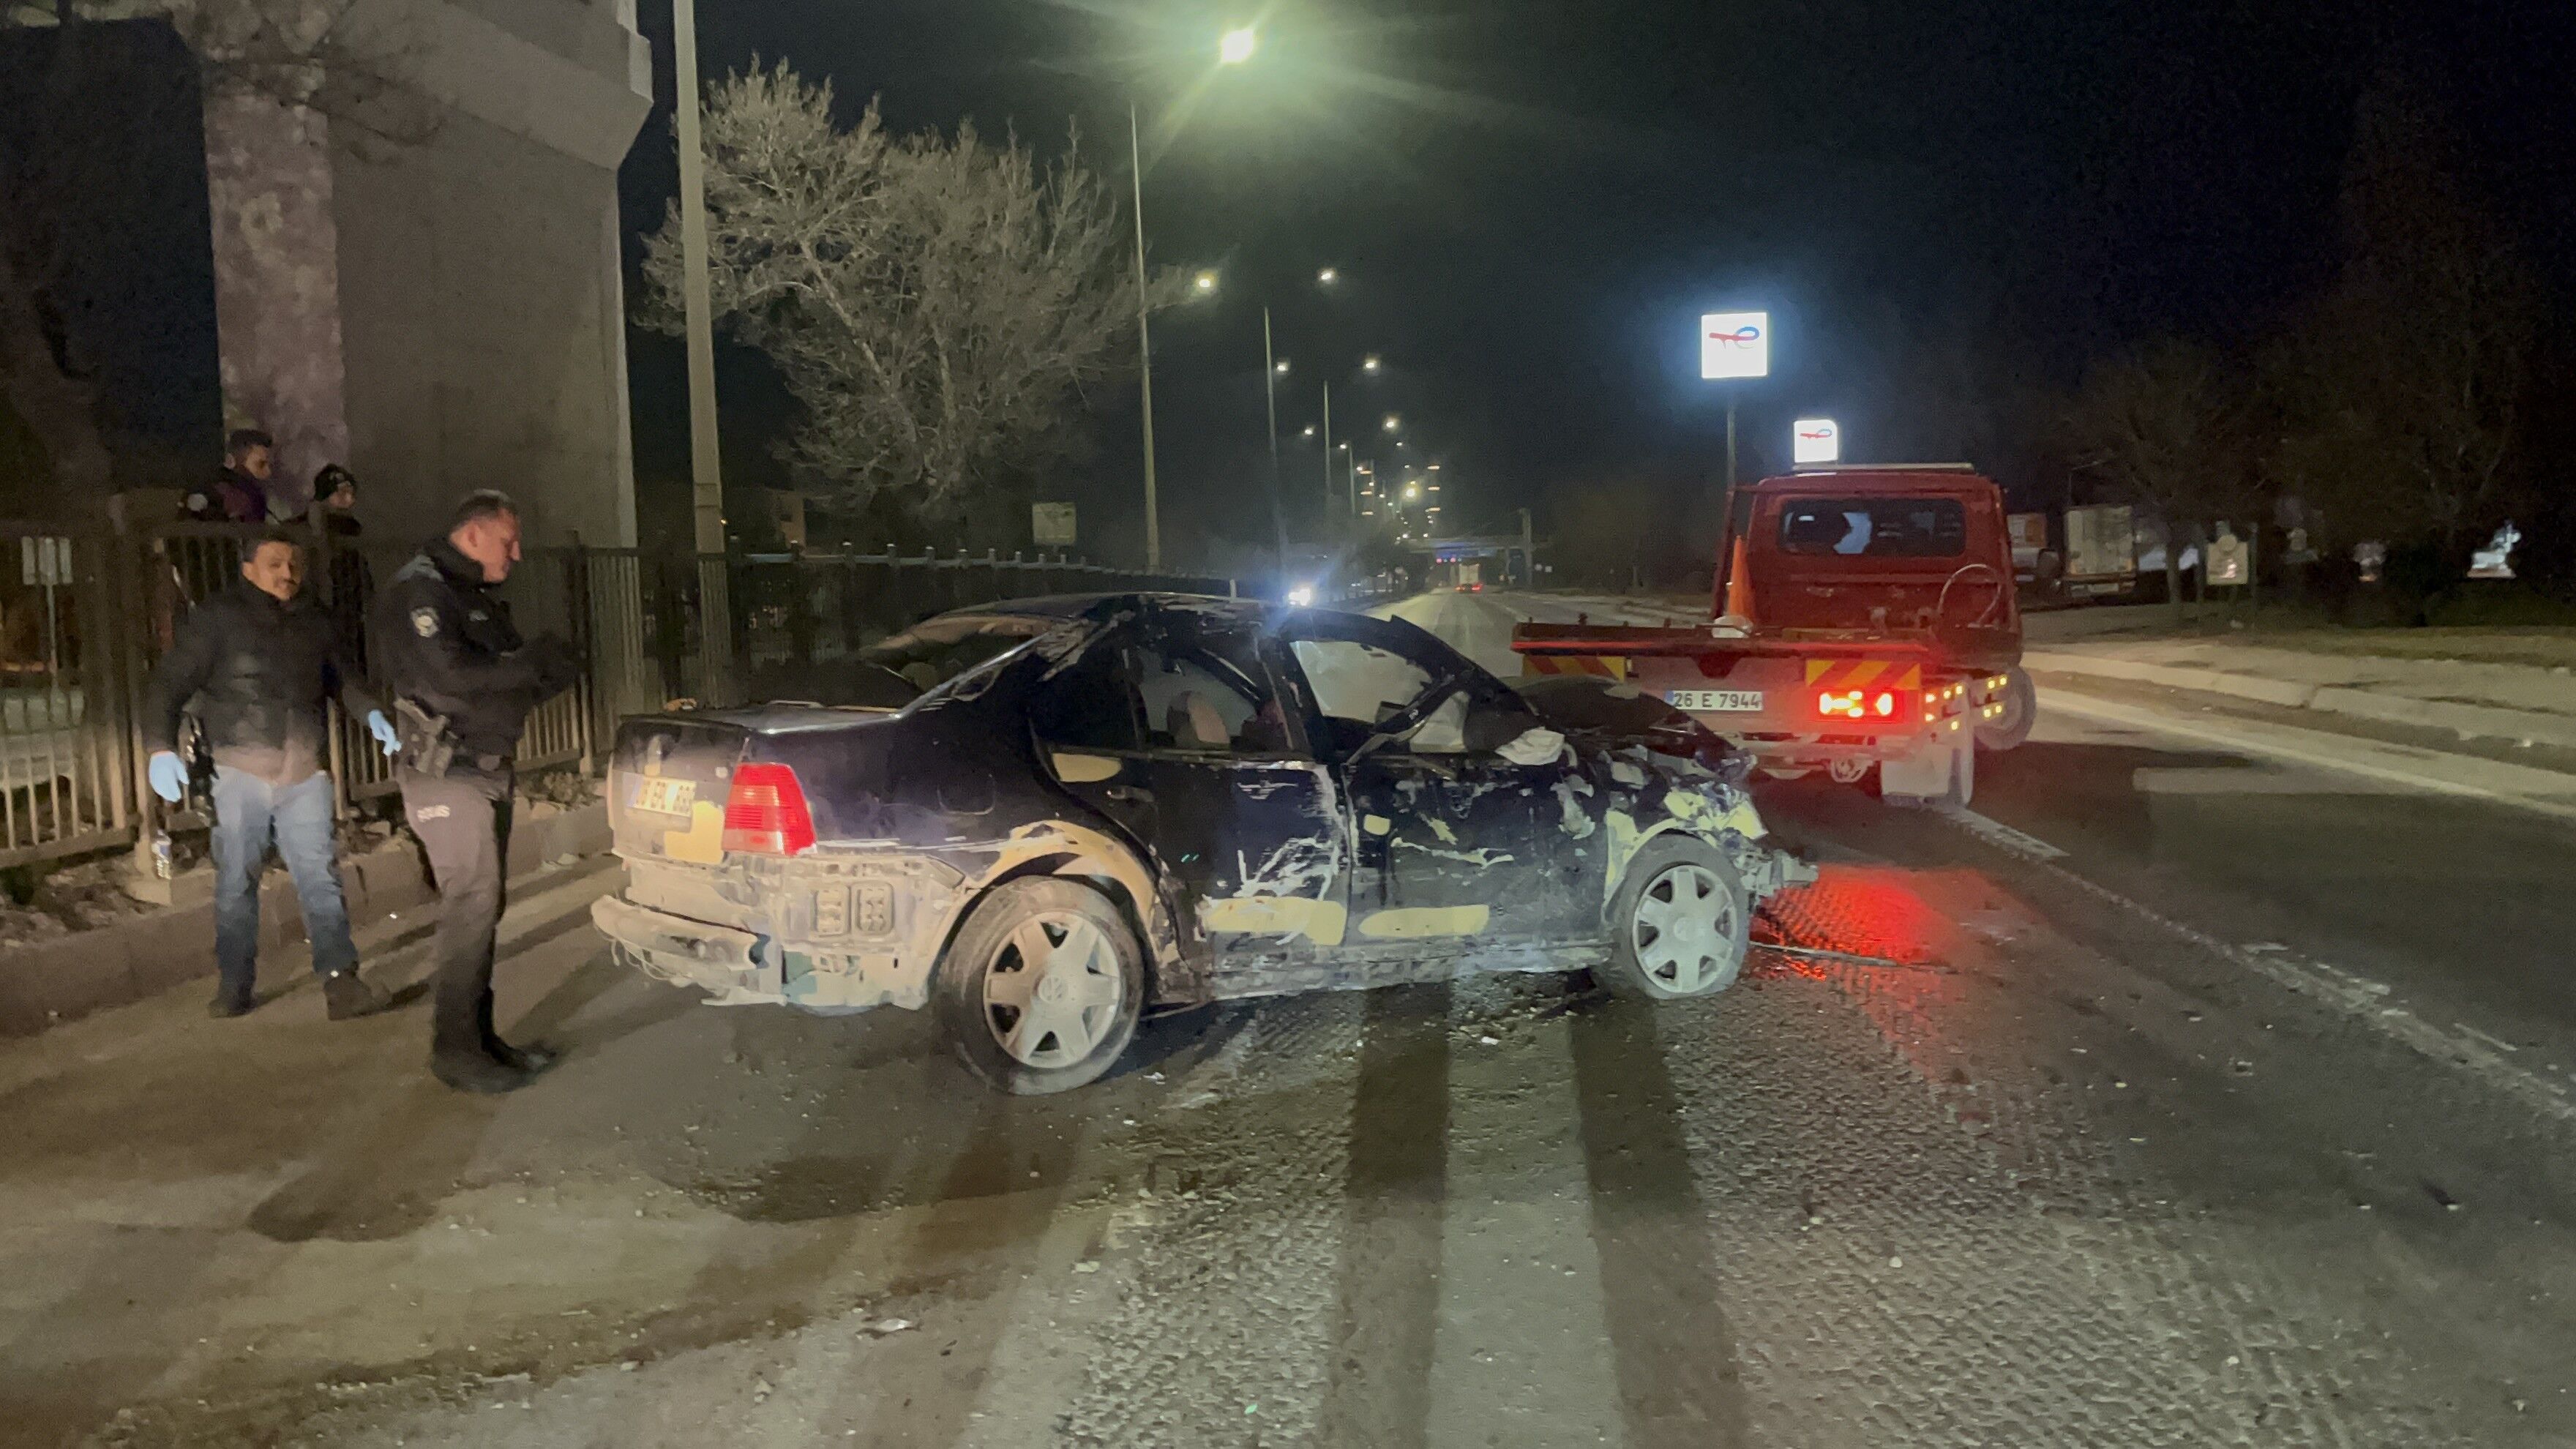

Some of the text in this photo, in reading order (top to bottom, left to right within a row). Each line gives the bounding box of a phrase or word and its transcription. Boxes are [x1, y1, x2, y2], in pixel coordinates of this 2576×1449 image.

[1674, 692, 1760, 708] 26 E 7944
